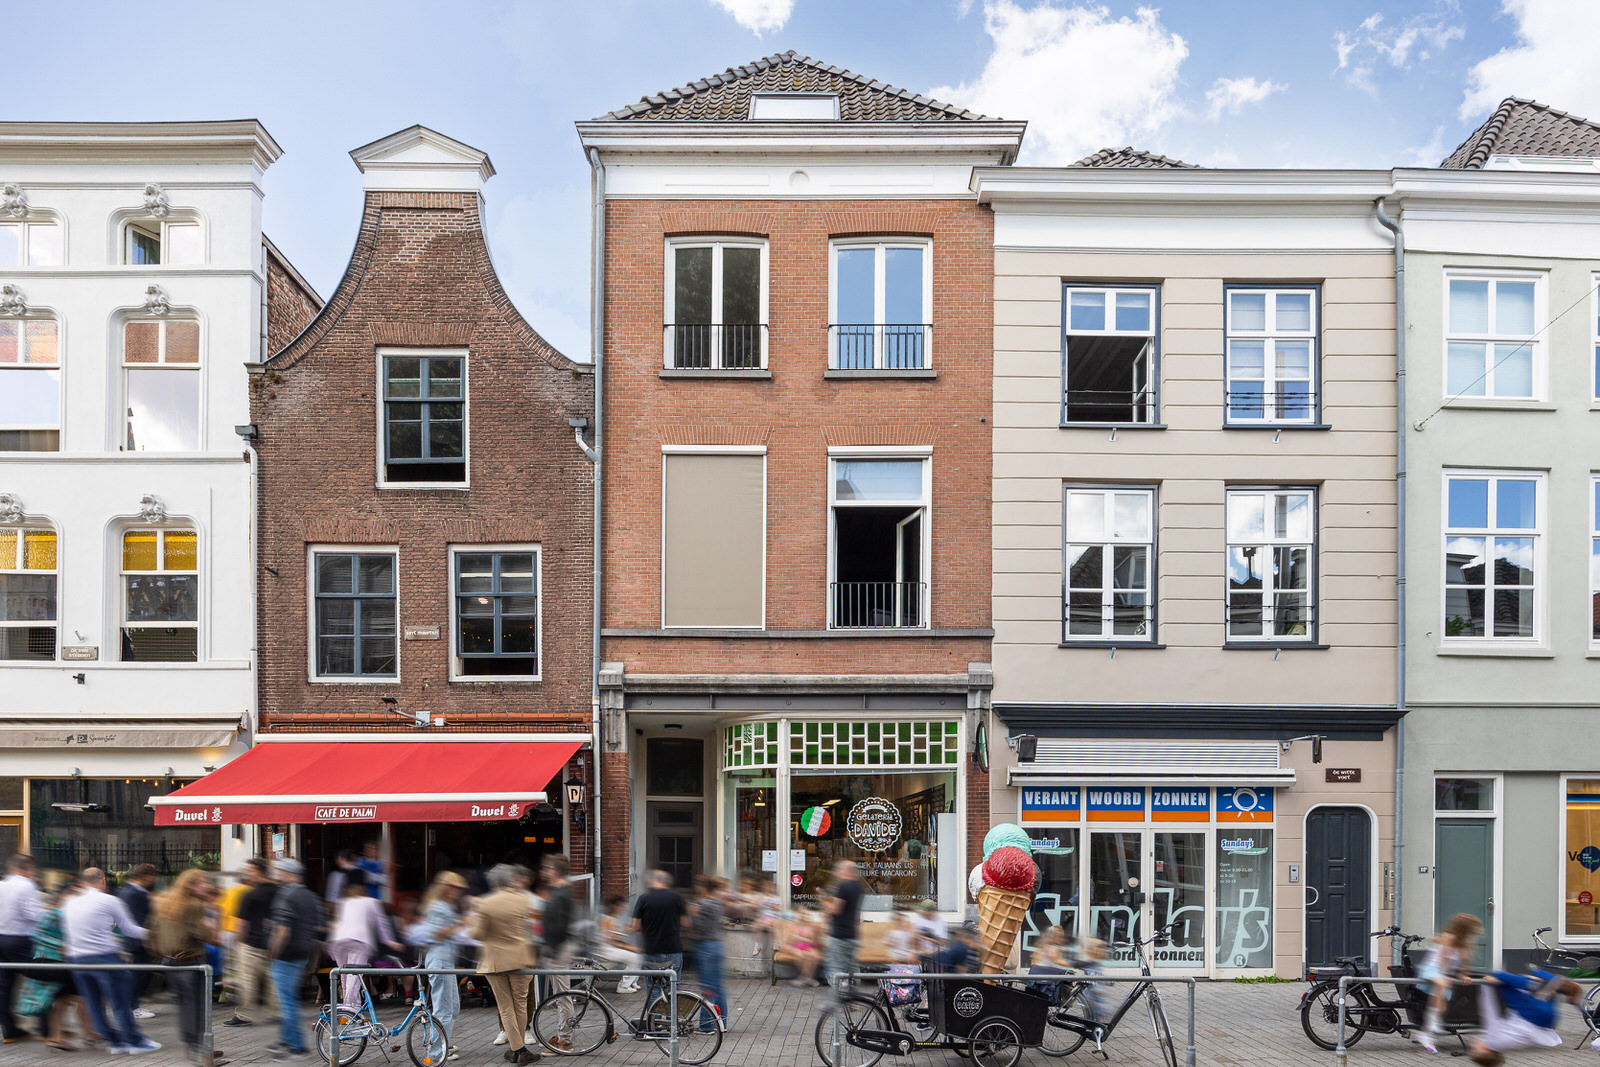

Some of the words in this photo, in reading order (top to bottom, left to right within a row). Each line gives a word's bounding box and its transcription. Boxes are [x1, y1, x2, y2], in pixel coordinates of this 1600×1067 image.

[1024, 791, 1078, 805] VERANT
[1089, 791, 1142, 806] WOORD
[1153, 792, 1207, 806] ZONNEN
[175, 808, 207, 821] Duvel
[317, 806, 337, 818] CAFÉ
[339, 808, 350, 818] DE
[351, 808, 373, 818] PALM
[471, 804, 504, 817] Duvel
[1029, 837, 1060, 849] unday's
[1221, 838, 1254, 848] Sunday's
